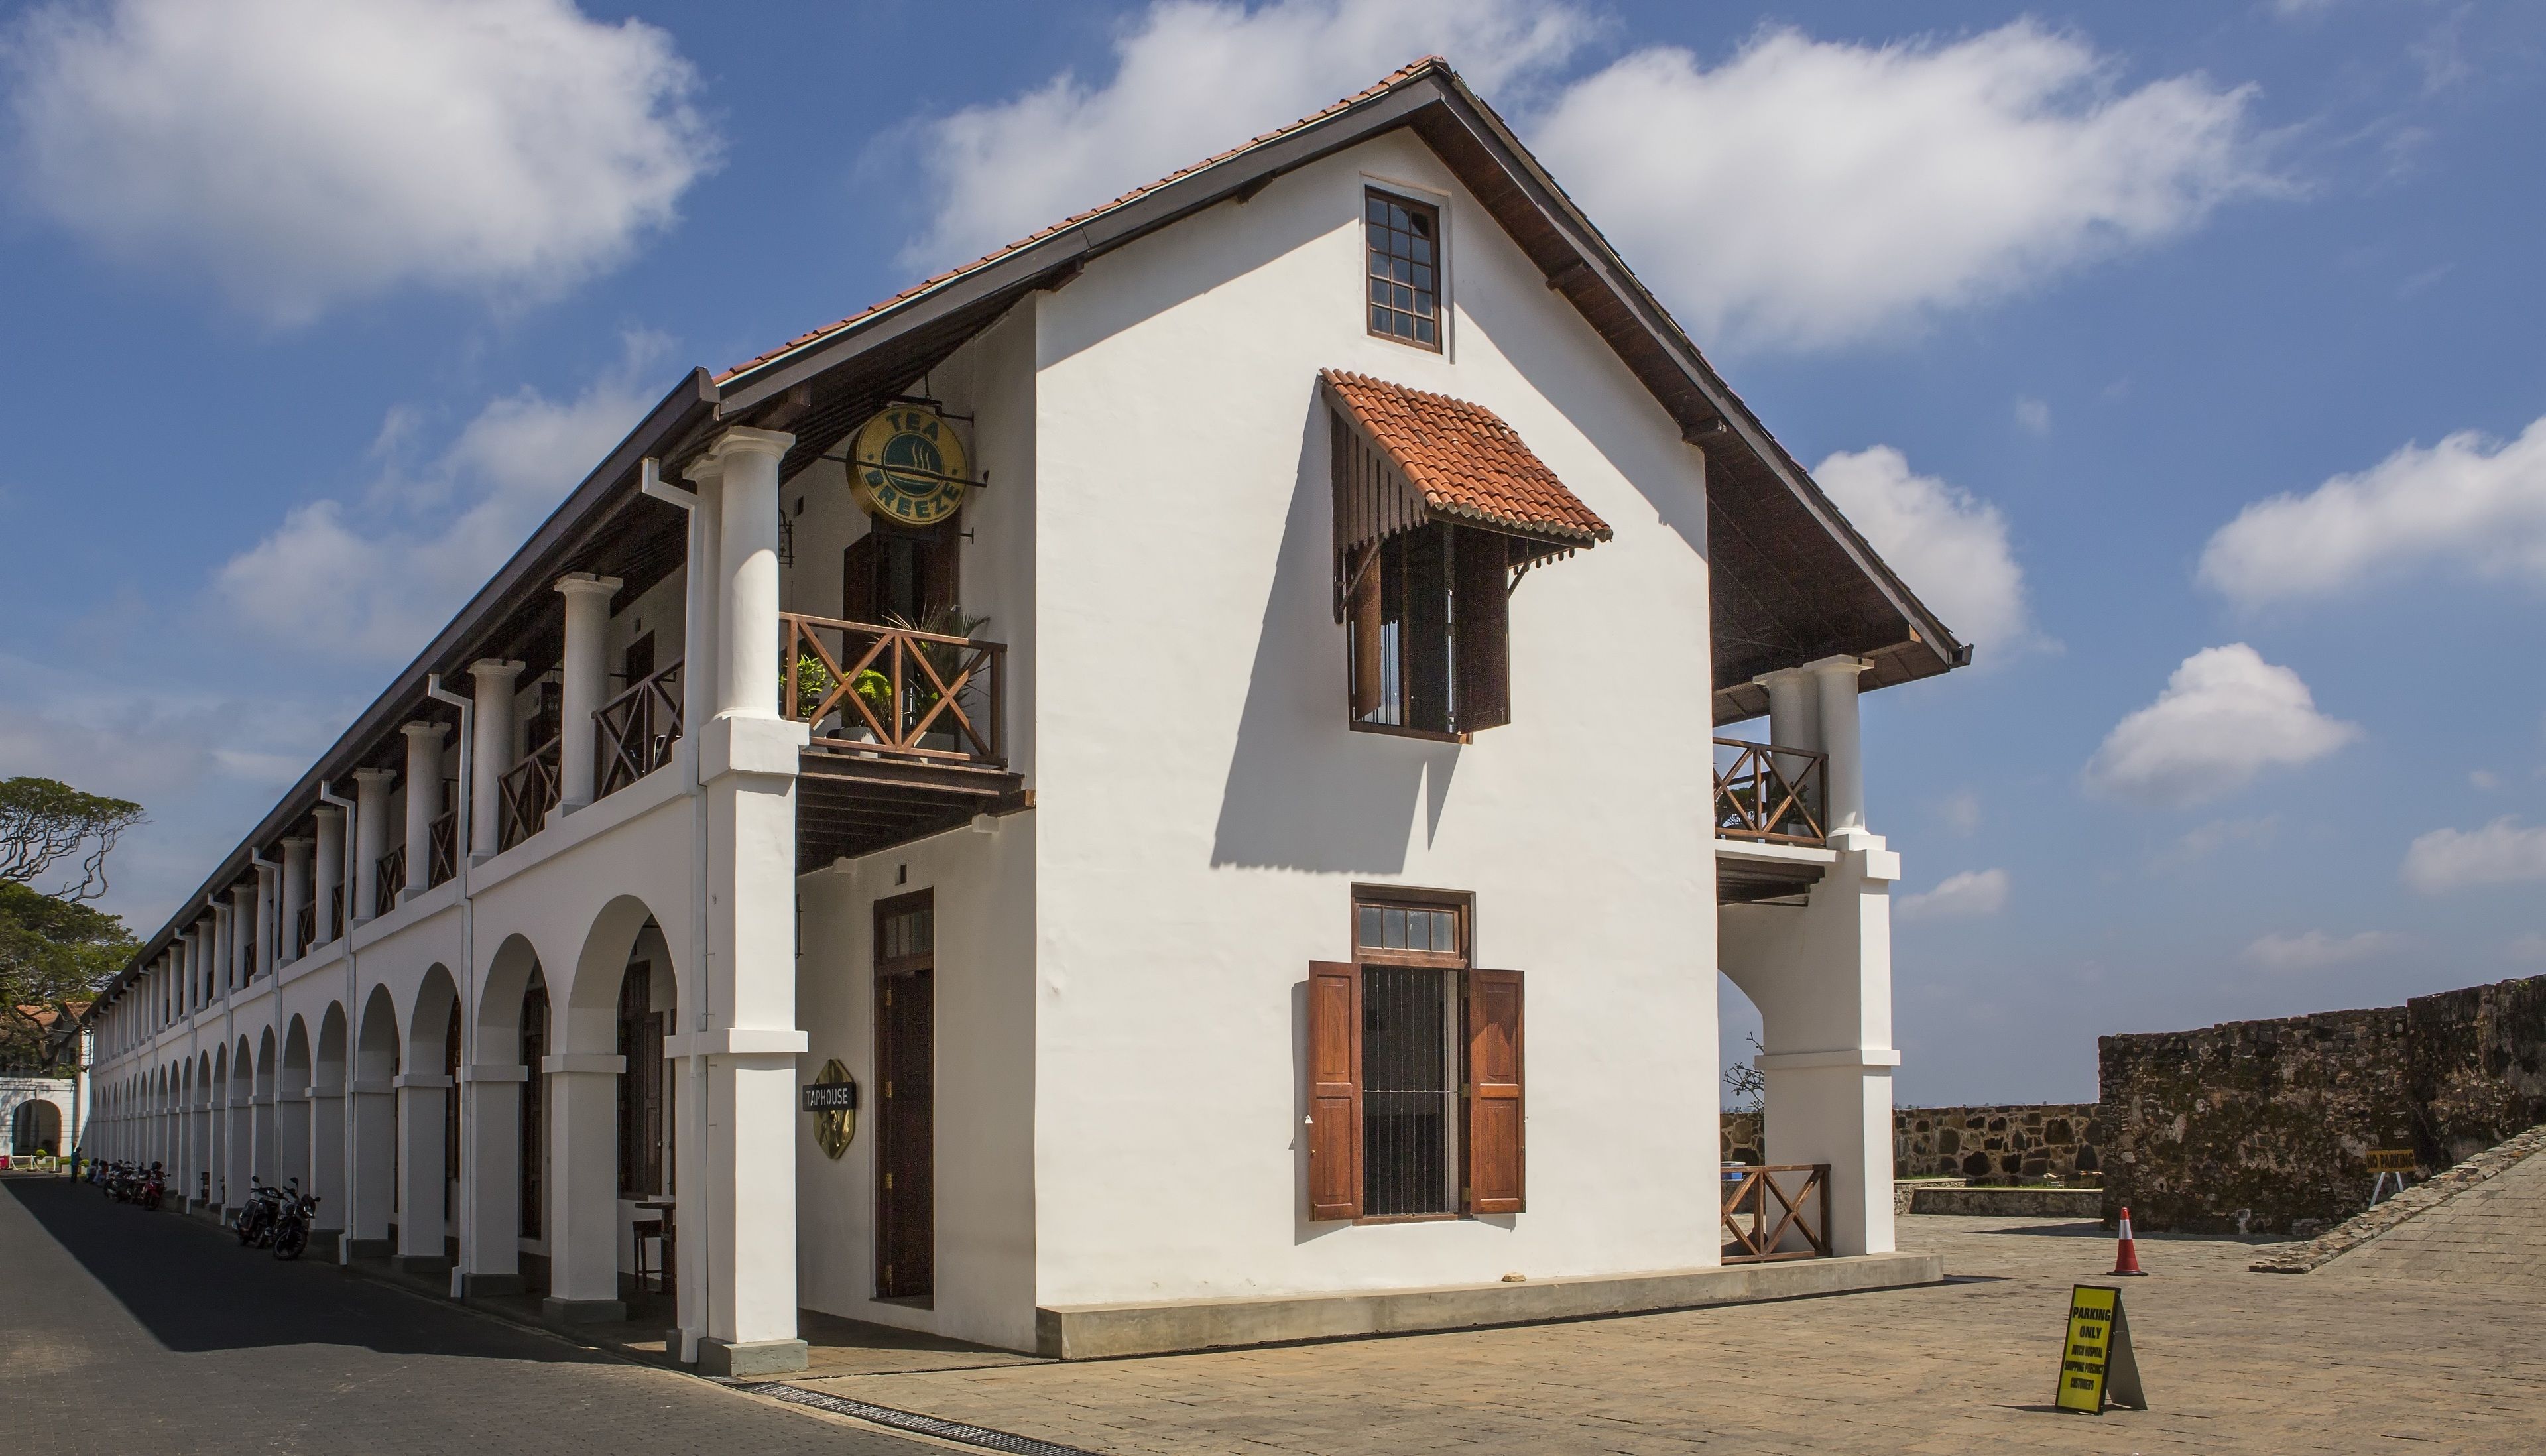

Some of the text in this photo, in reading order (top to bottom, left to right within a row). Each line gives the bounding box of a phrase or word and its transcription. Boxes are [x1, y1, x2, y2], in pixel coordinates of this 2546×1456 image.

[886, 412, 939, 441] TEA
[865, 469, 960, 518] BREEZE
[806, 1087, 848, 1106] TAPHOUSE
[2367, 1152, 2415, 1168] NO PARKING
[2073, 1307, 2111, 1321] PARKING
[2079, 1326, 2102, 1339] ONLY
[2085, 1346, 2102, 1358] HOSPITAL
[2065, 1360, 2085, 1372] SHOPPING
[2071, 1377, 2094, 1390] CUSTOMERS
